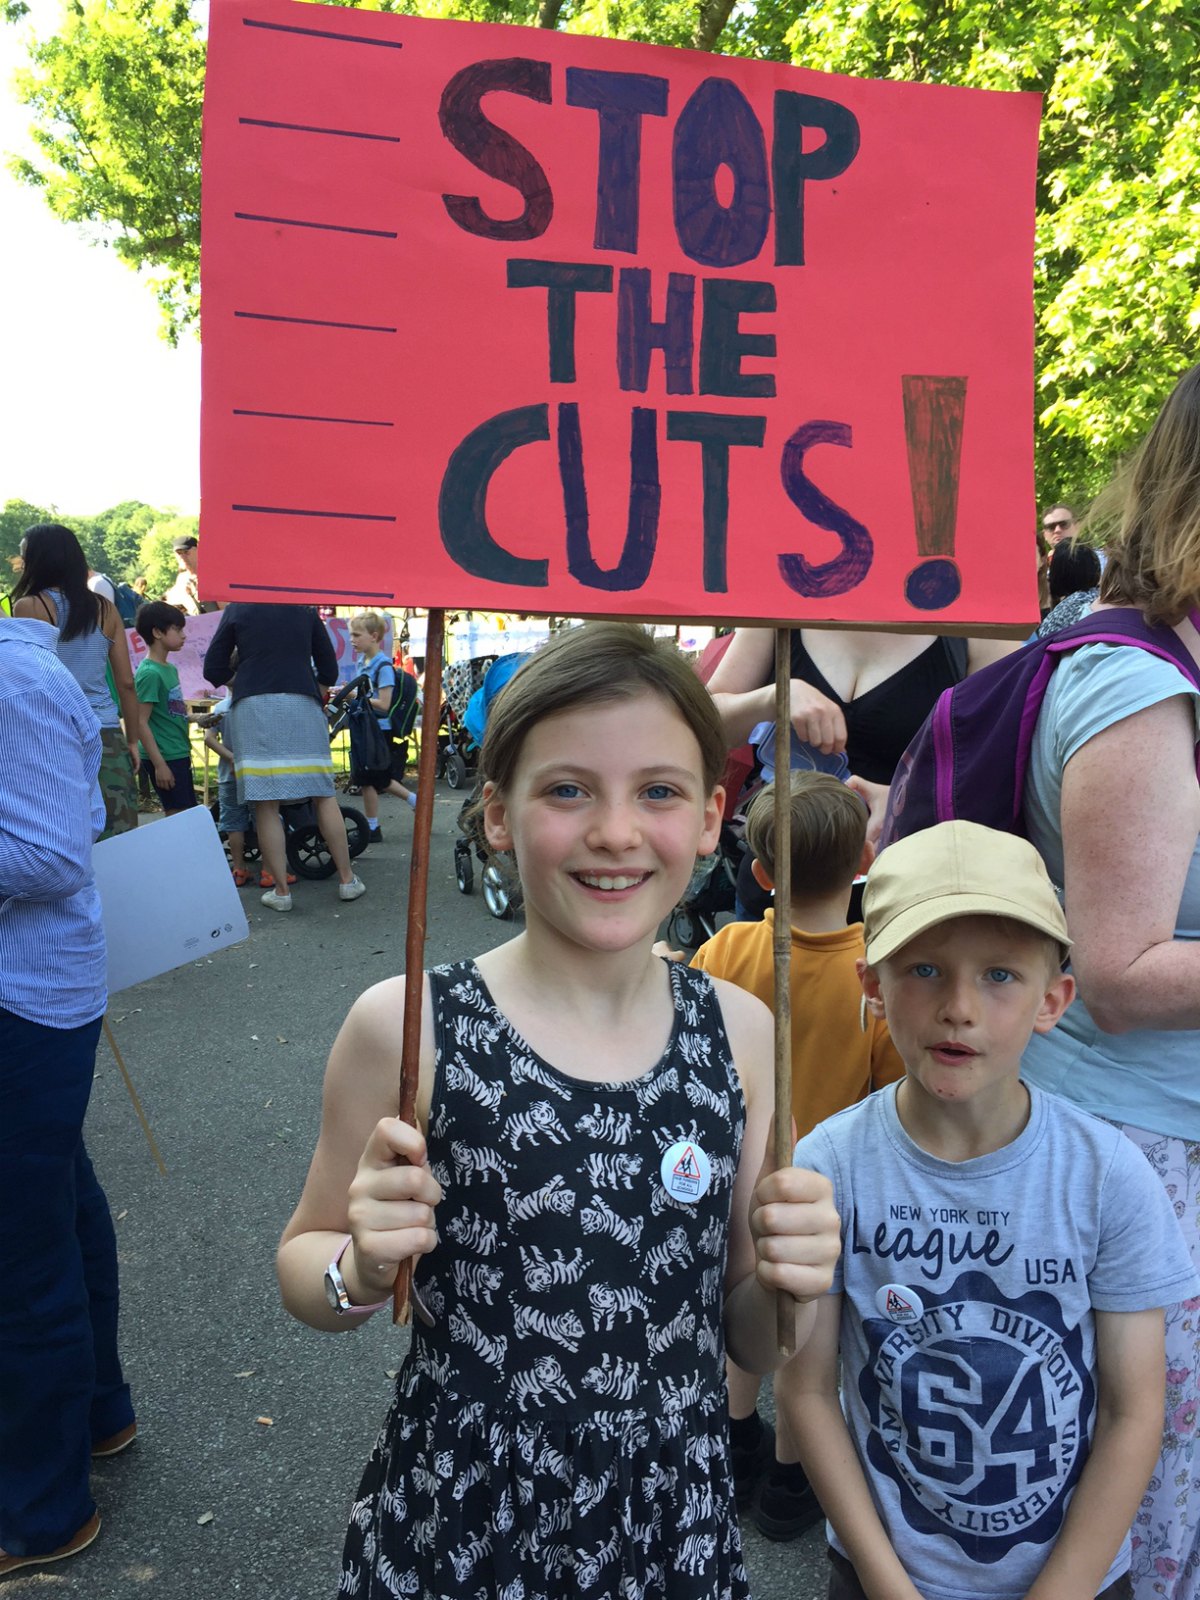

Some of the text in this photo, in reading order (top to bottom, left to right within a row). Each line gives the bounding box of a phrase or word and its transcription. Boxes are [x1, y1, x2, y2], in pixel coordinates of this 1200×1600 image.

[439, 57, 860, 267] STOP
[507, 259, 777, 398] THE
[852, 1206, 1015, 1281] League
[889, 1204, 1011, 1227] NEW YORK CITY
[1024, 1257, 1078, 1285] USA
[877, 1304, 1081, 1400] VARSITY DIVISION
[901, 1351, 1059, 1489] 64
